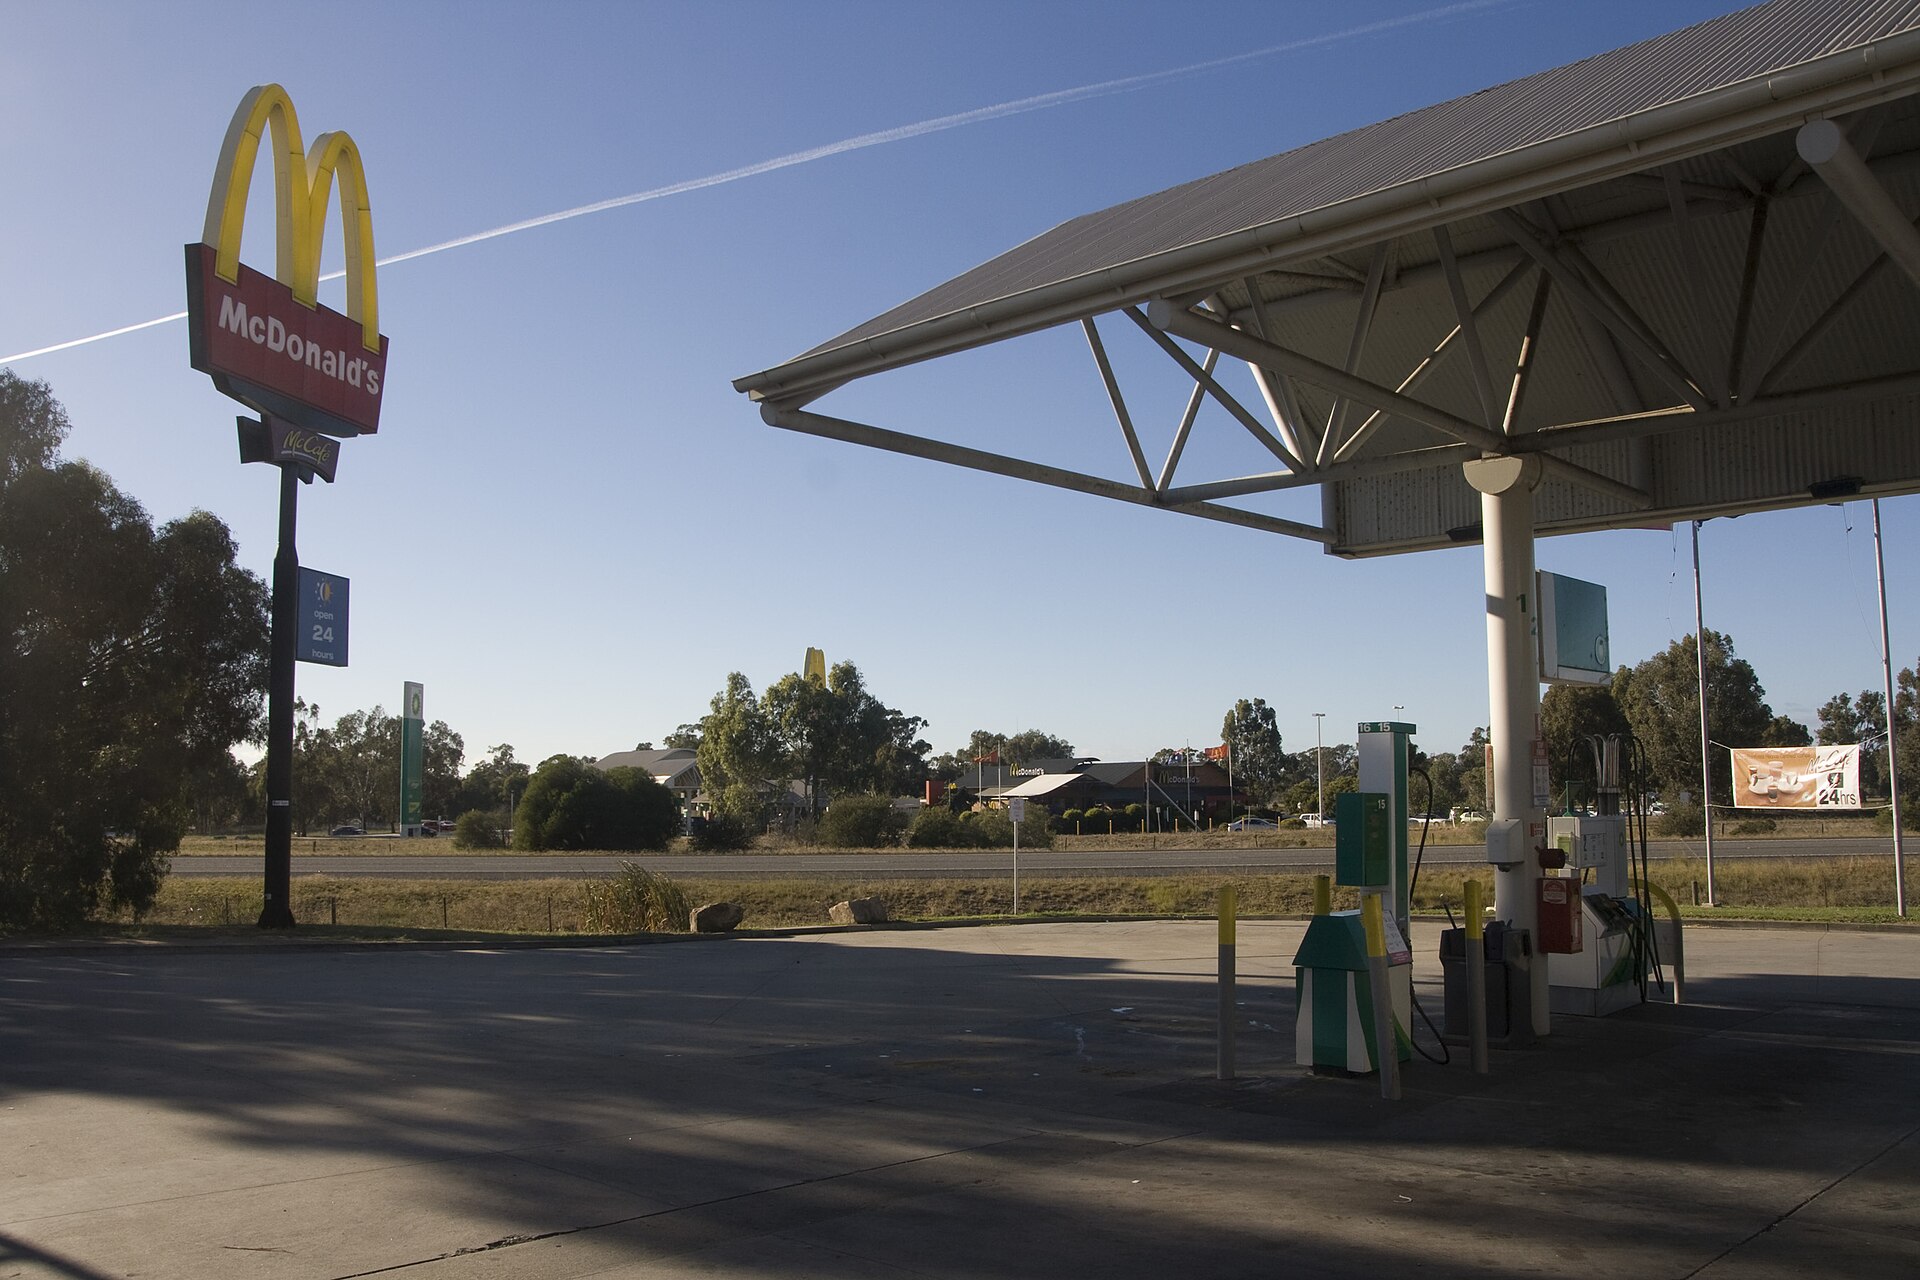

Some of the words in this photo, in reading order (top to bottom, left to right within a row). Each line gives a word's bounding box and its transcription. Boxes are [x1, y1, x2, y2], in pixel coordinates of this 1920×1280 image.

[218, 294, 379, 395] McDonald's
[313, 610, 334, 621] open
[312, 624, 334, 643] 24
[312, 648, 334, 660] hours
[1358, 723, 1371, 732] 16
[1377, 722, 1391, 732] 15
[1159, 770, 1200, 783] McDonld's
[1377, 799, 1386, 809] 15
